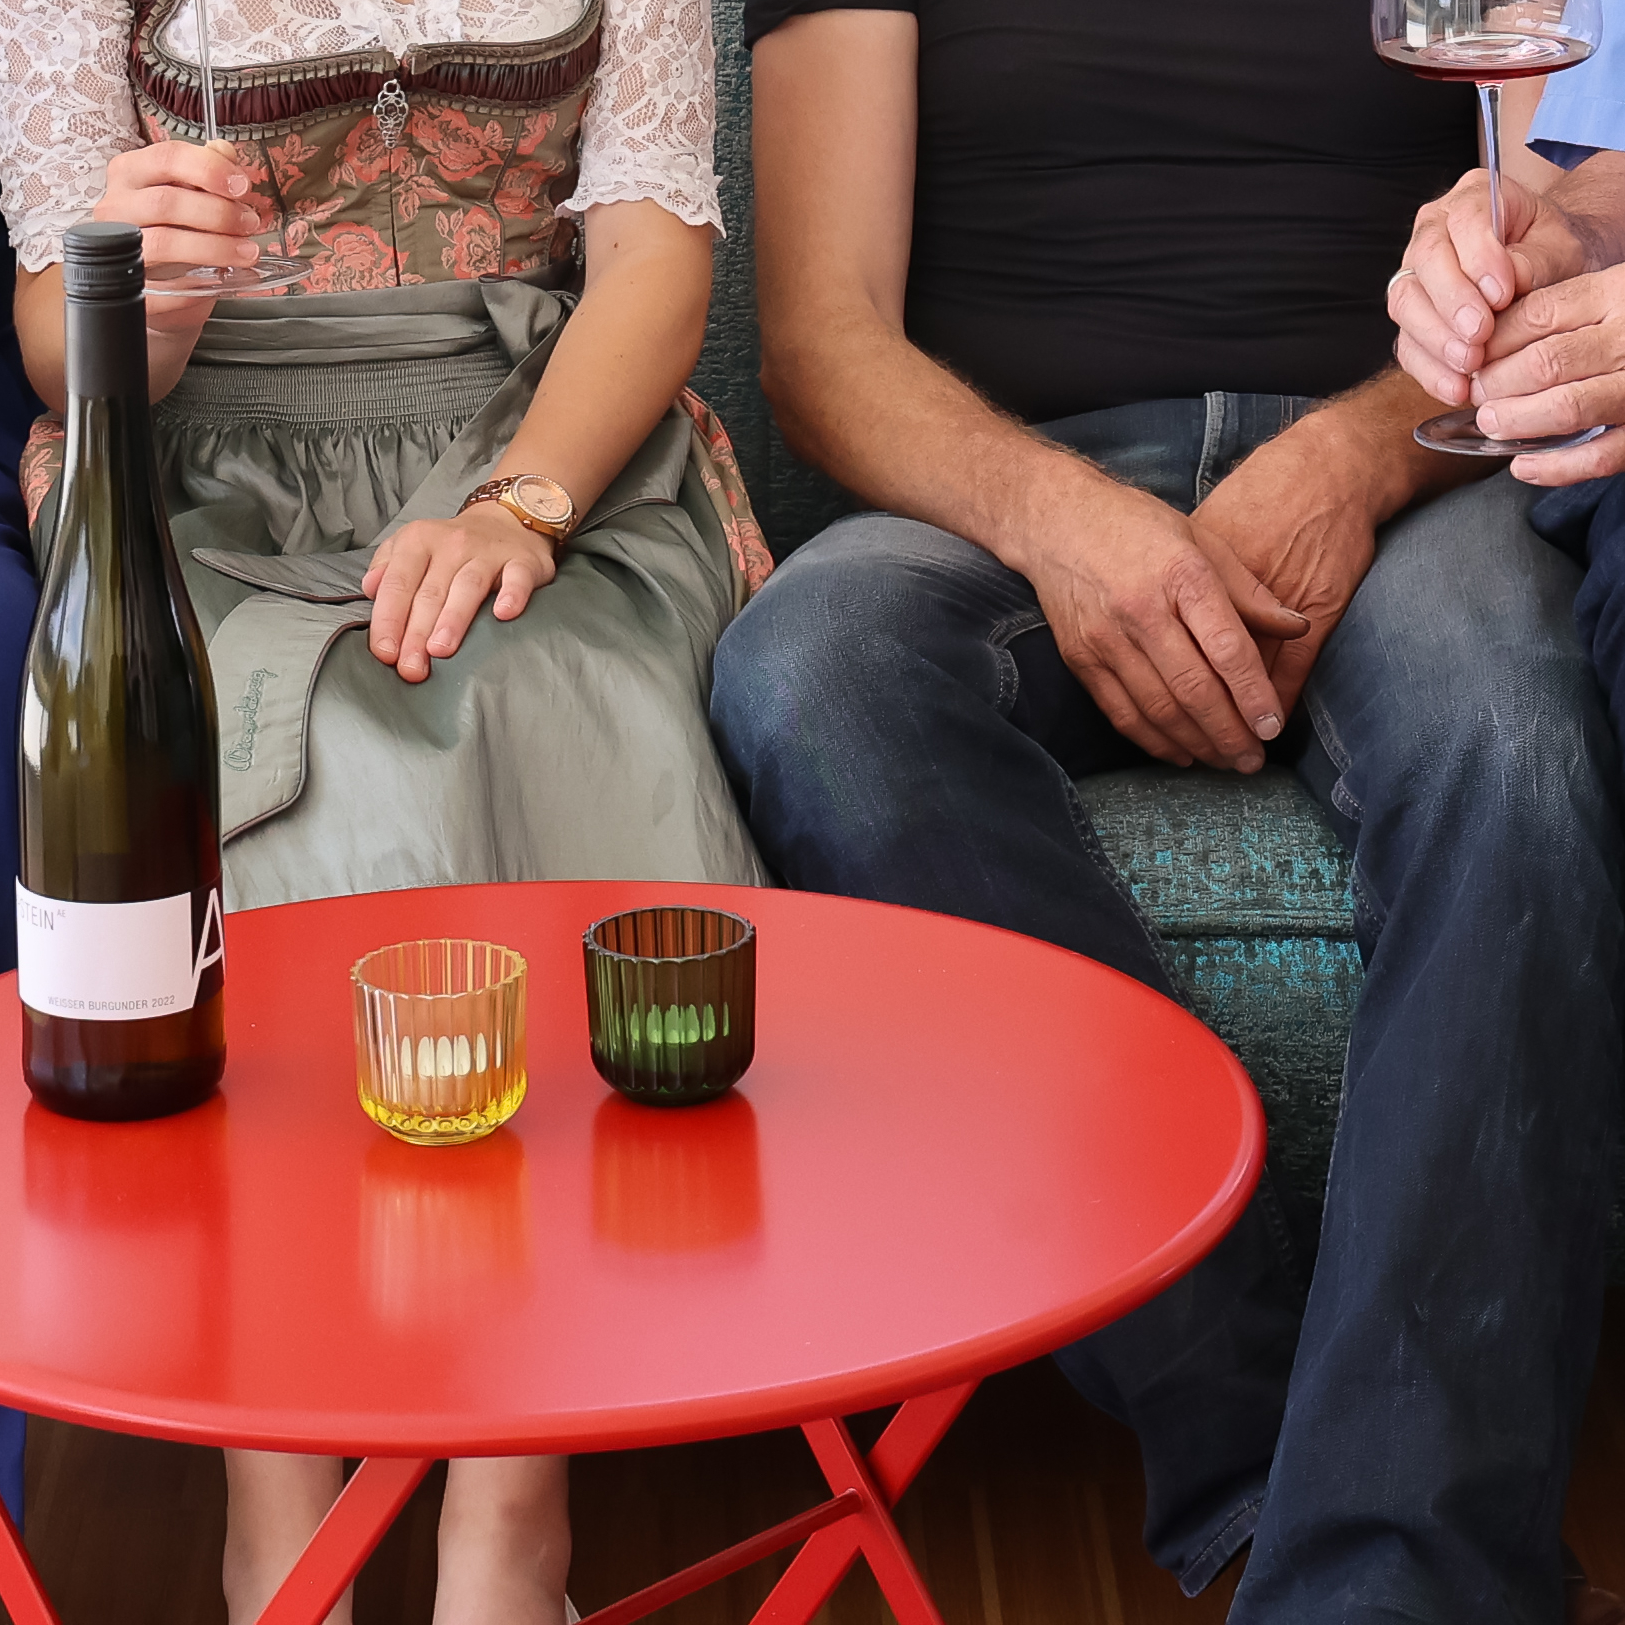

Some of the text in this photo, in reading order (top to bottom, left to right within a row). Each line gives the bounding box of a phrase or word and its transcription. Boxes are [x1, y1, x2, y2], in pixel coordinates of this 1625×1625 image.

[18, 898, 54, 931] STEIN
[47, 994, 176, 1011] WEISSER BURGUNDER 2022
